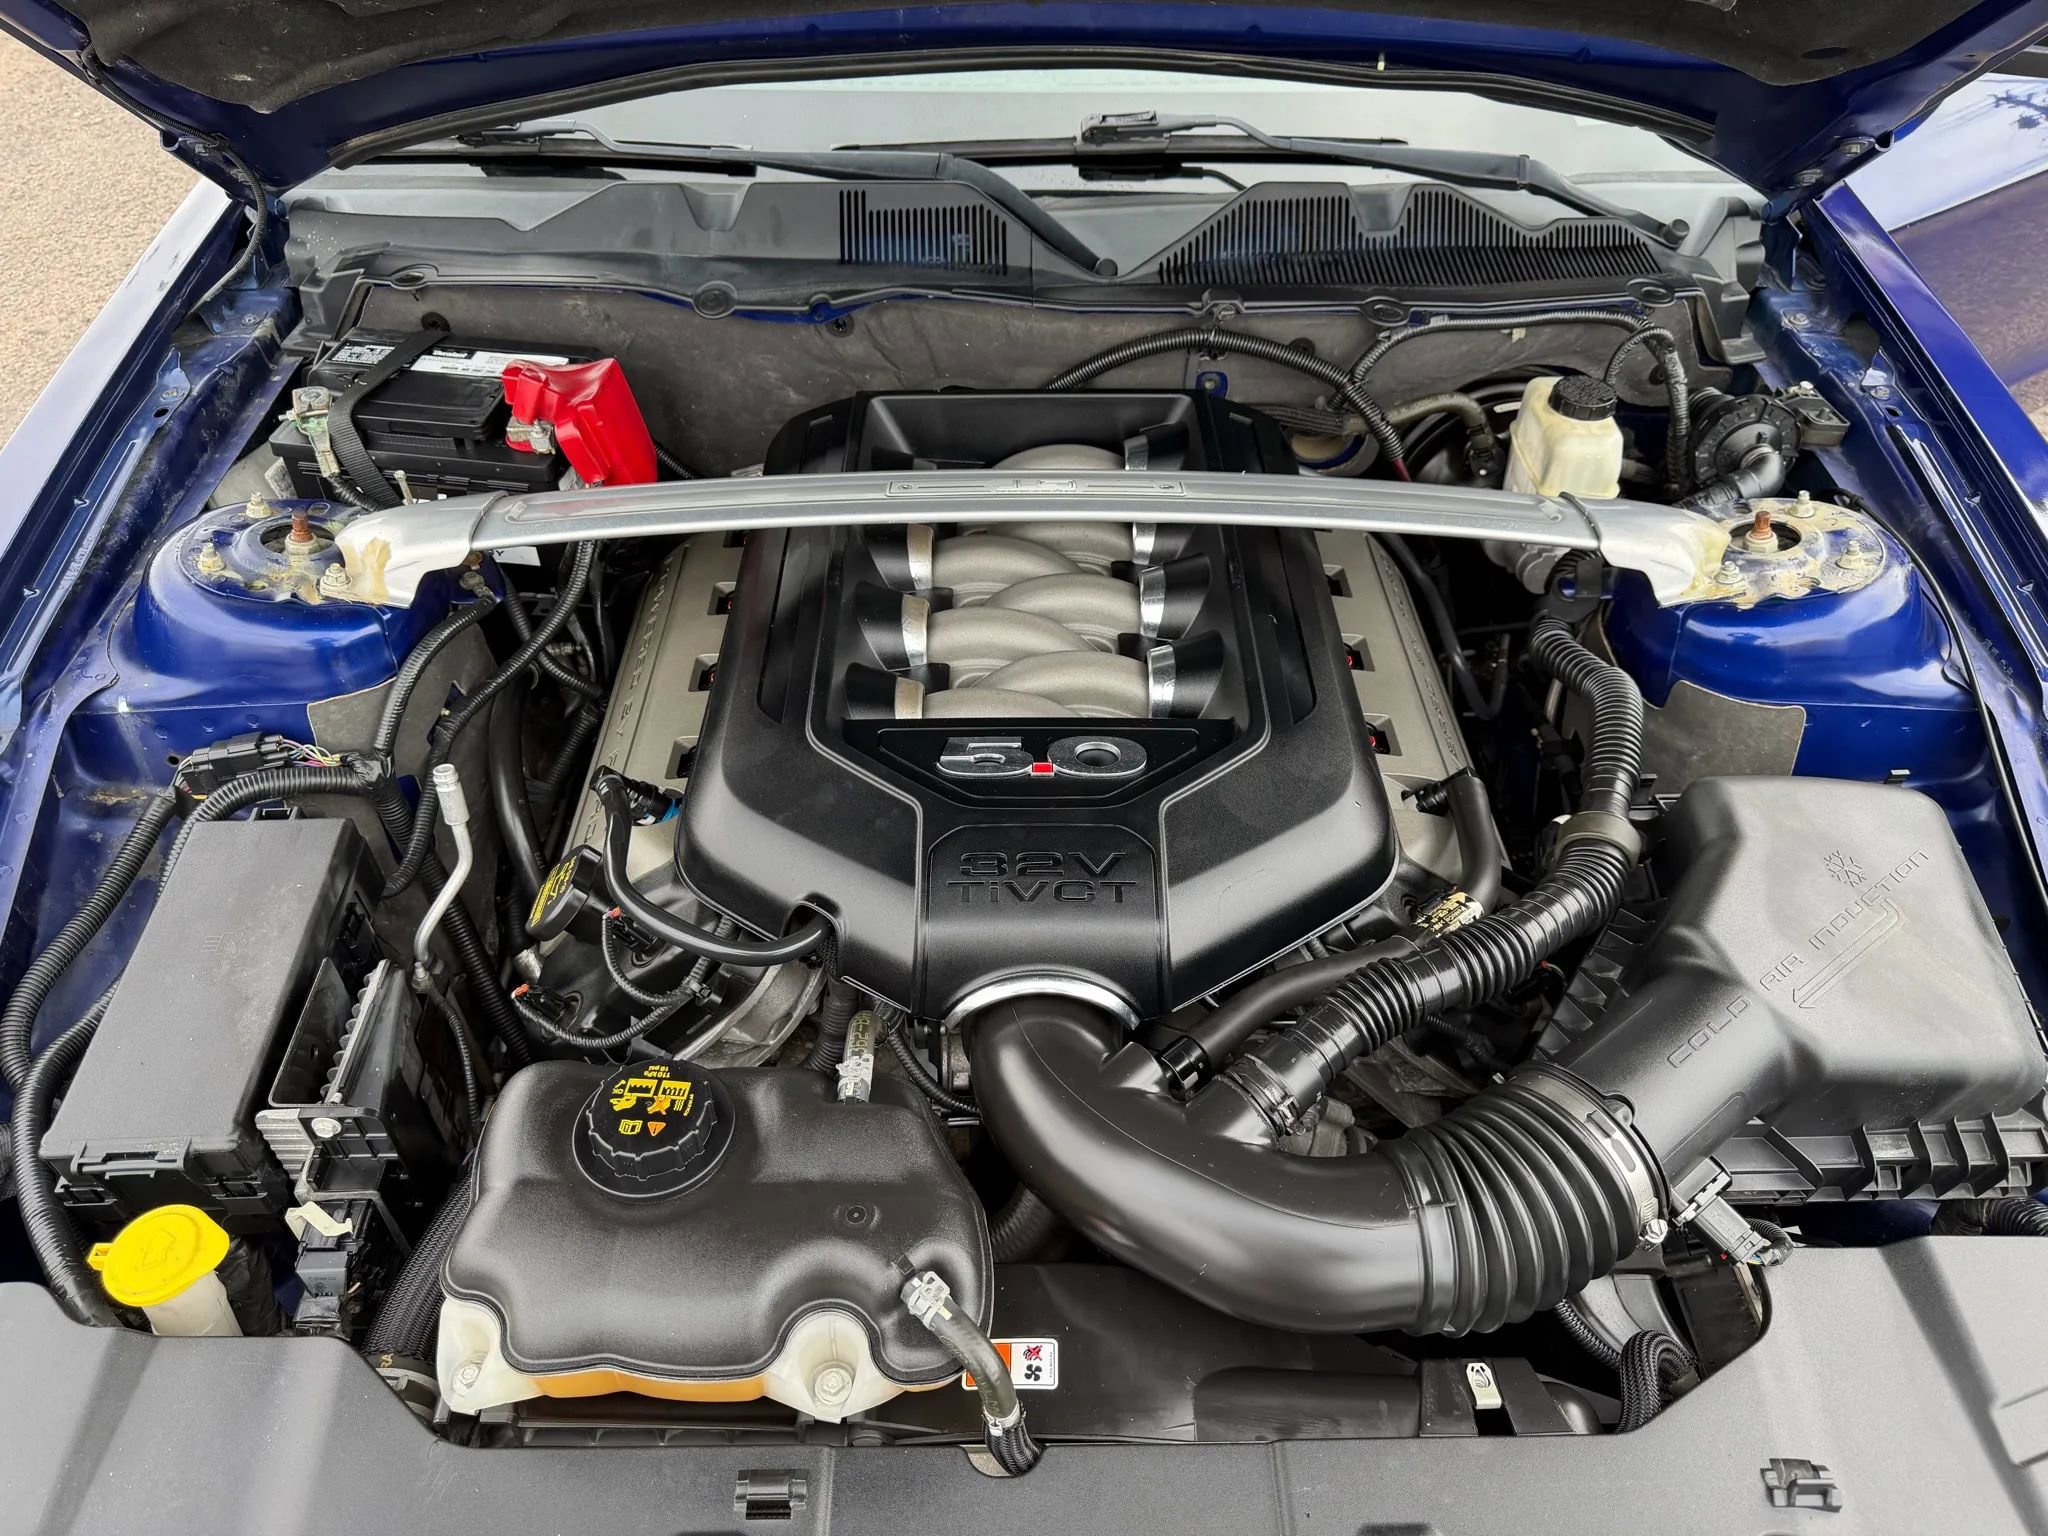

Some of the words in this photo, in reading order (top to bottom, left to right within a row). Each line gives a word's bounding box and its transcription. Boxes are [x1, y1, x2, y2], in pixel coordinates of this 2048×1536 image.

[936, 736, 1147, 779] 5.0
[960, 851, 1127, 877] 32V
[947, 880, 1137, 903] TiVCT
[1667, 996, 1751, 1068] COLD
[1759, 953, 1805, 991] AIR
[1808, 849, 1930, 950] INDUCTION
